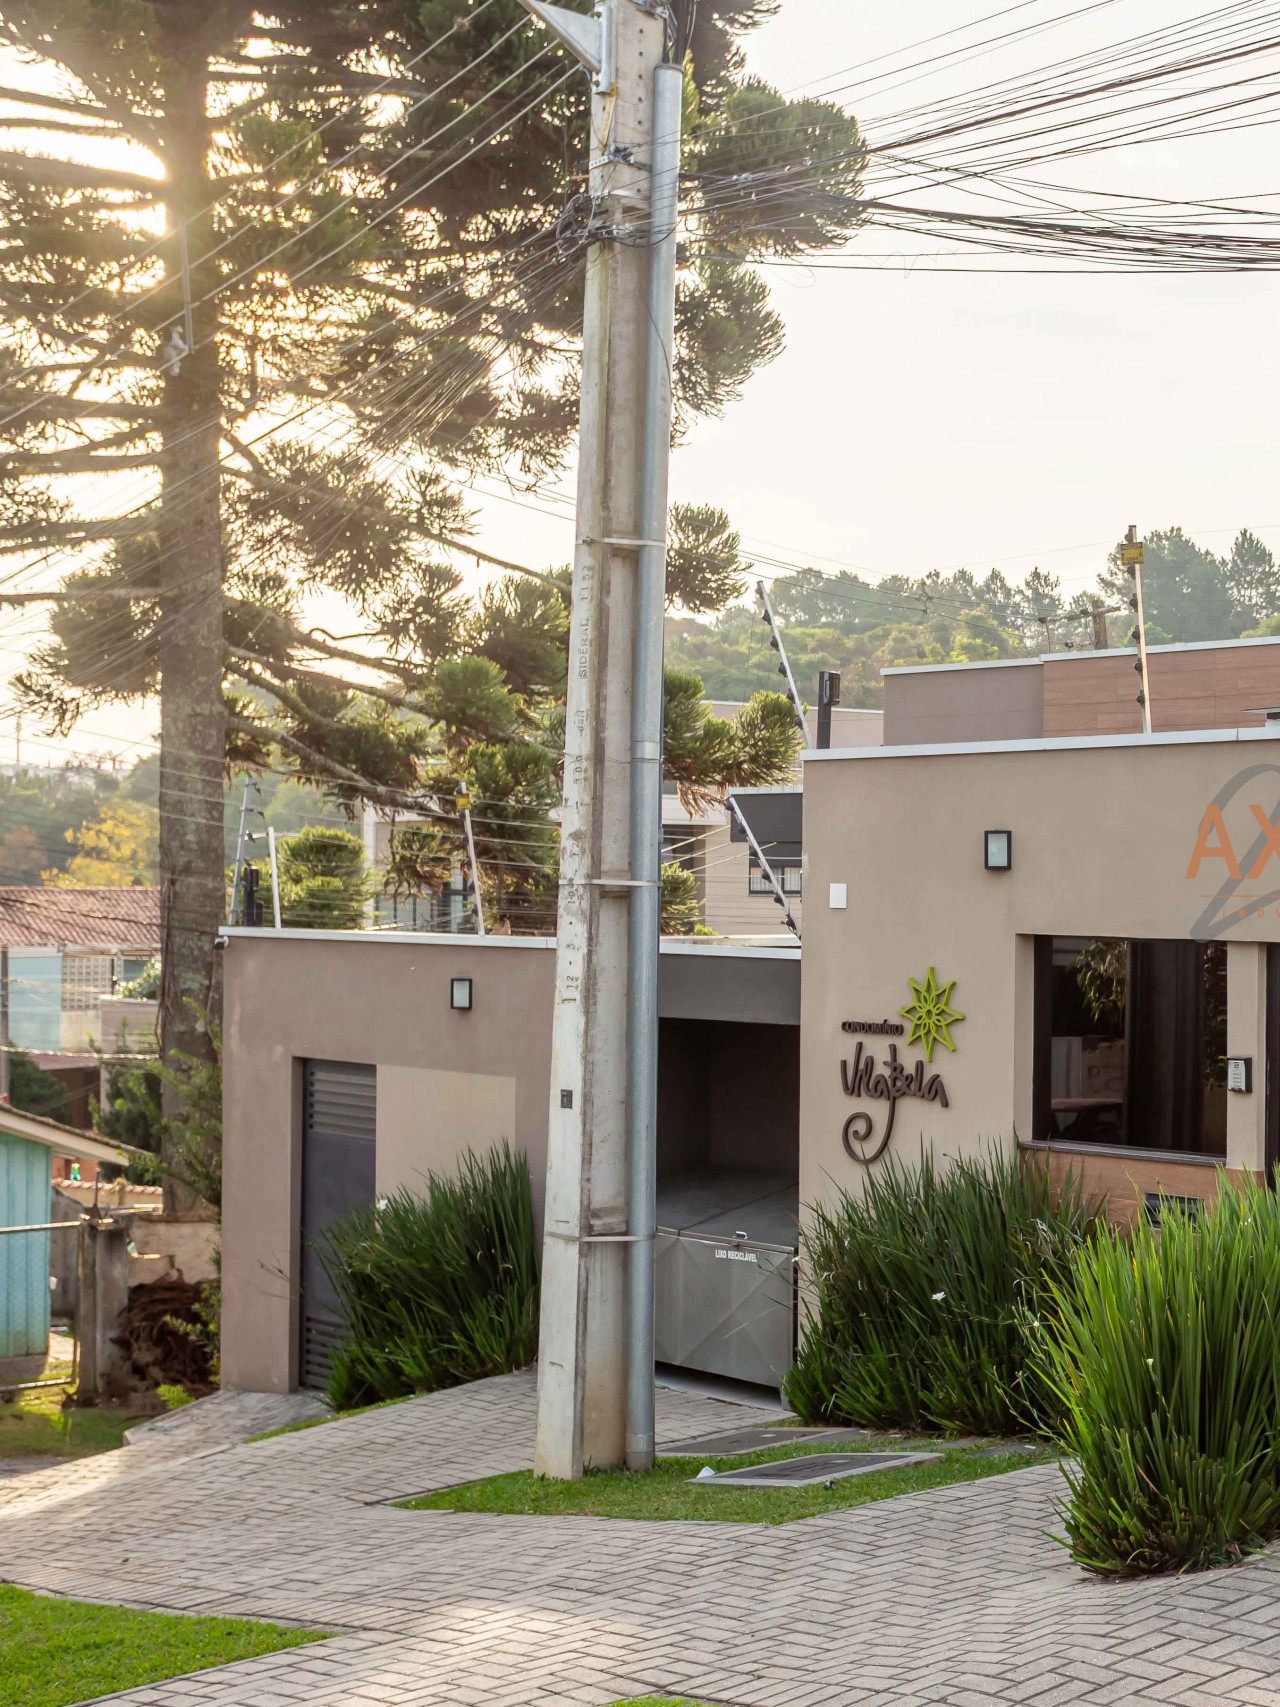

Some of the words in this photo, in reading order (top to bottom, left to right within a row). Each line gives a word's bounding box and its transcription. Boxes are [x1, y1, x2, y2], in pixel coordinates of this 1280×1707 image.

[578, 618, 589, 679] SIDERAL
[841, 1019, 904, 1036] CONDOMÍNIO
[715, 1249, 727, 1258] LIXO
[727, 1250, 758, 1262] RECICLÁVEL
